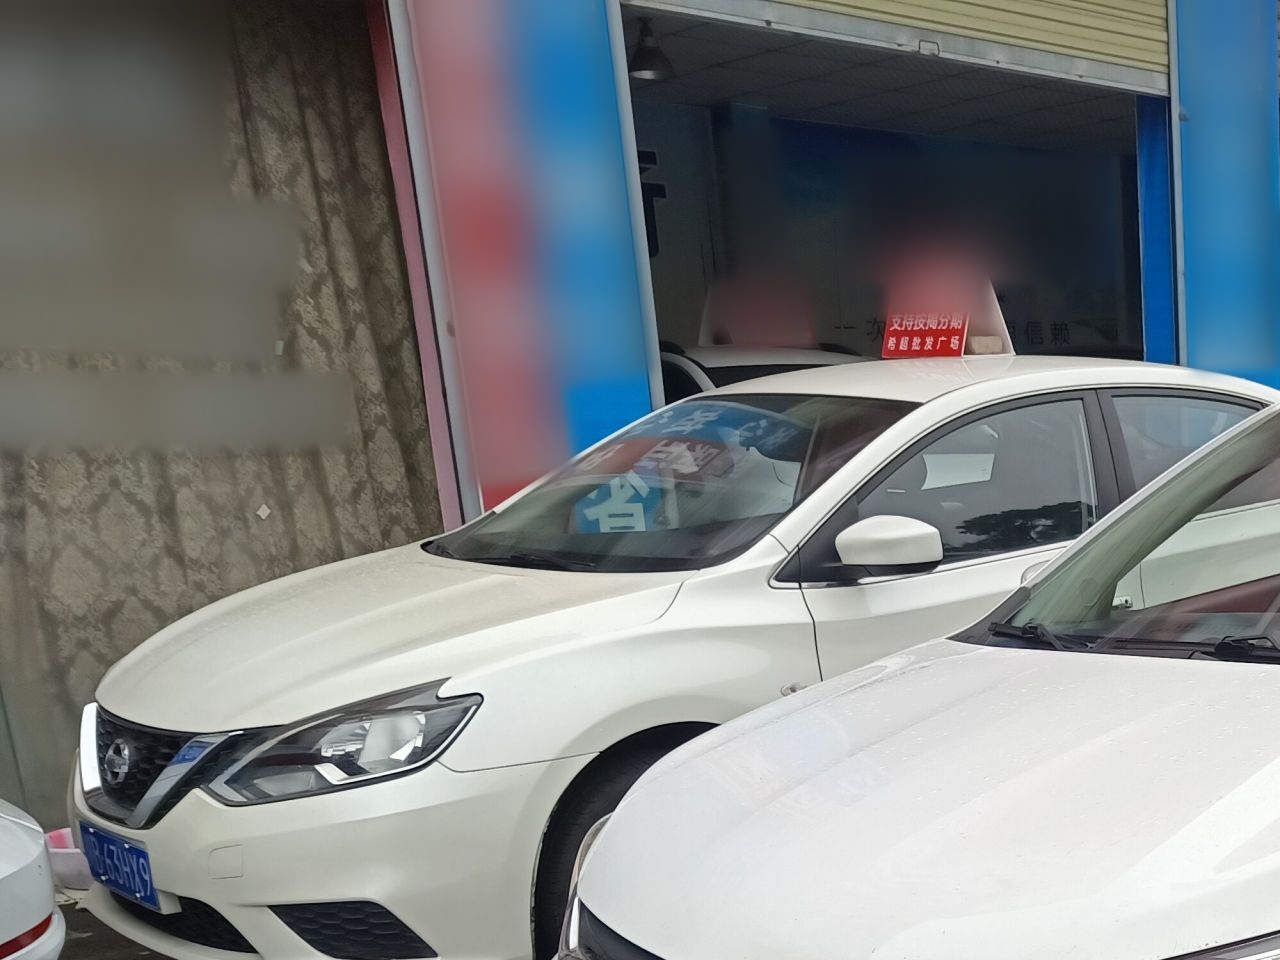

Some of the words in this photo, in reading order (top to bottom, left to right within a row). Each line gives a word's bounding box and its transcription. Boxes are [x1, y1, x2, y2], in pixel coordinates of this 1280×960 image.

[889, 312, 964, 331] 支持按揭分期
